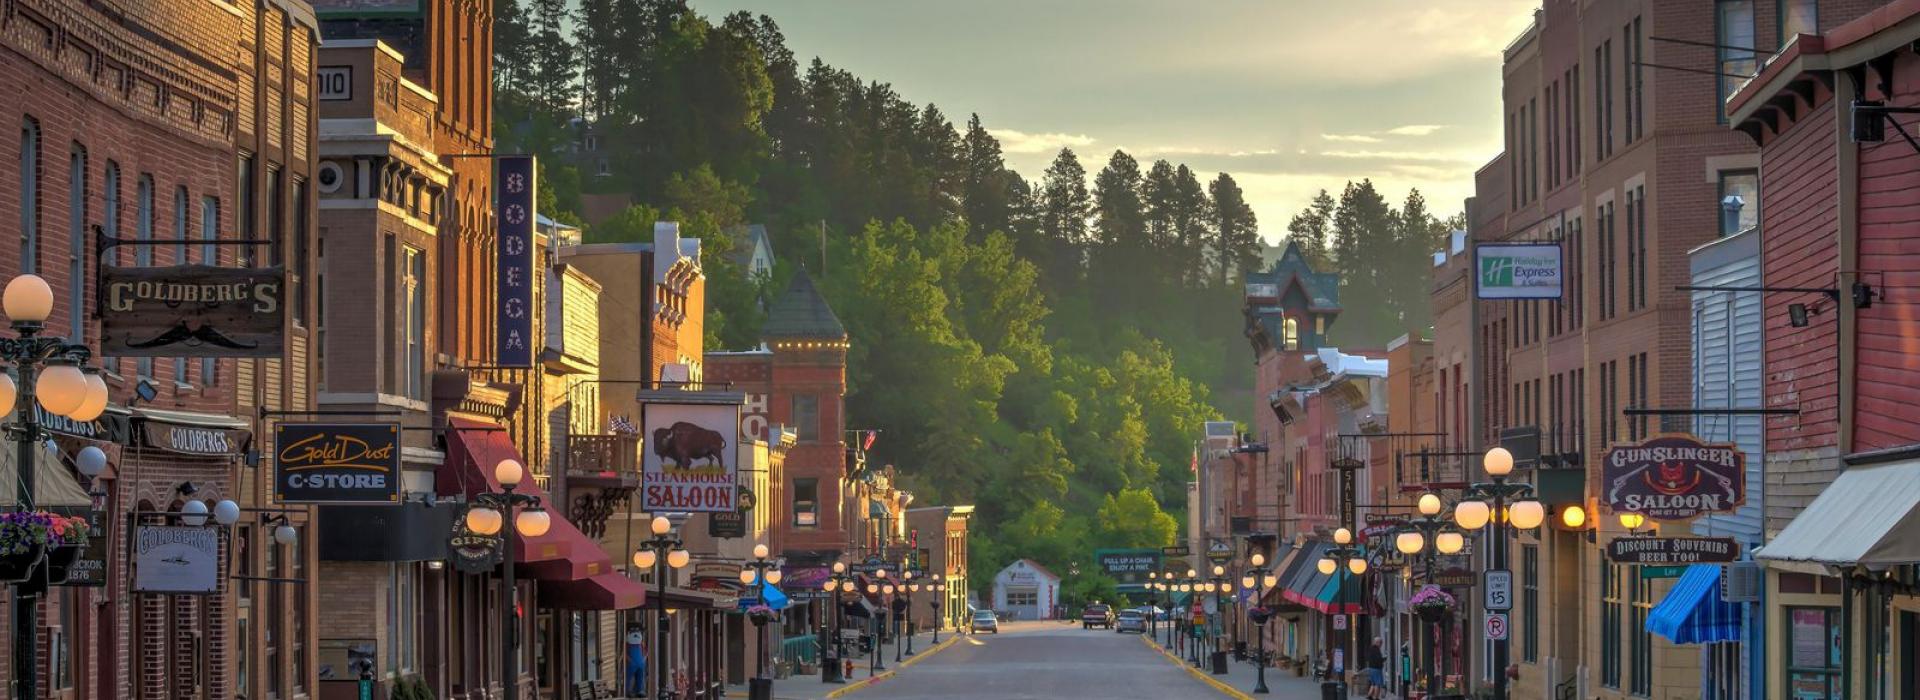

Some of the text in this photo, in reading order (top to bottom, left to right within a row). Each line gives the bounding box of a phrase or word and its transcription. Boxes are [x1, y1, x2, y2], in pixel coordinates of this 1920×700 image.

[505, 172, 525, 350] BODEGA
[1514, 267, 1556, 278] Express
[110, 279, 278, 314] GOLDBERG'S
[171, 427, 228, 452] GOLDBERGS
[280, 433, 394, 464] Gold Dust
[1612, 447, 1735, 467] GUNSLINGER
[645, 472, 734, 484] STEAKHOUSE
[647, 486, 732, 509] SALOON
[1625, 494, 1721, 511] SALOON
[451, 536, 497, 548] GIFT
[1617, 538, 1729, 555] DISCOUNT SOUVENIRS
[1640, 552, 1700, 562] BEER TOO!
[69, 570, 90, 580] 1876
[1491, 591, 1506, 605] 15
